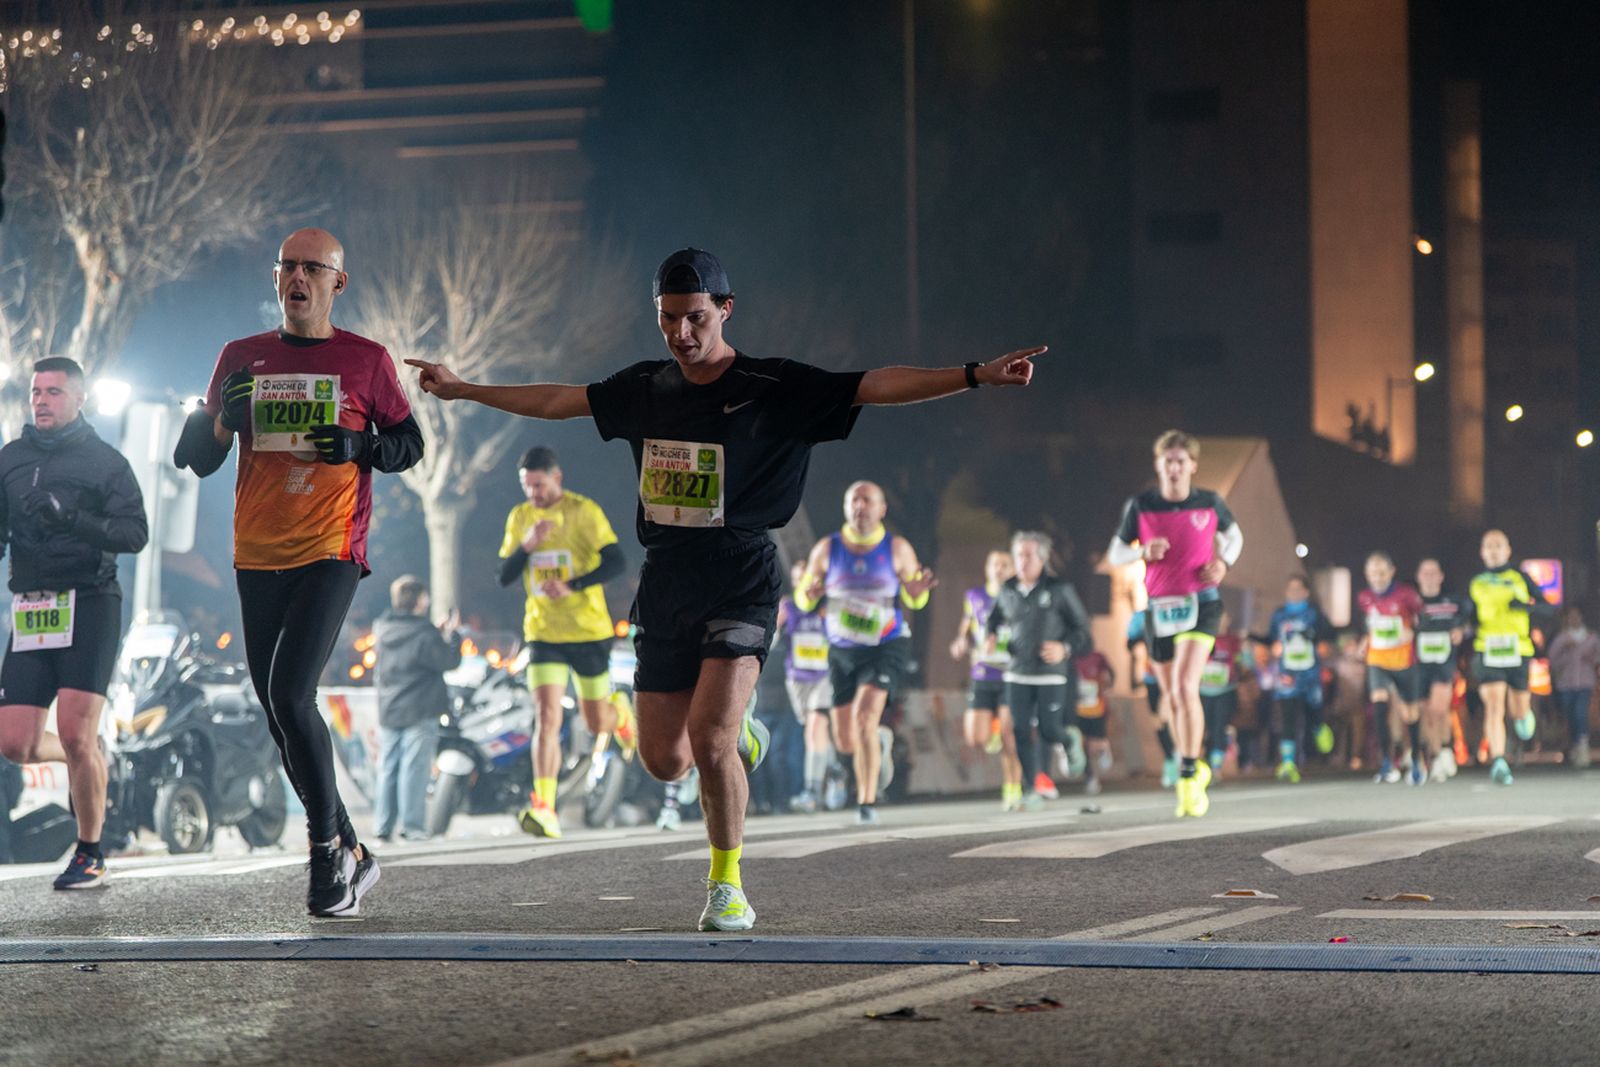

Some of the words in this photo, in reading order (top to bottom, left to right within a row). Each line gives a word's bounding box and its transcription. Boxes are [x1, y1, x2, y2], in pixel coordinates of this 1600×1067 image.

[272, 382, 296, 391] NOCHE
[297, 382, 307, 390] DE
[260, 392, 278, 400] SAN
[264, 401, 326, 424] 12074
[660, 450, 681, 460] NOCHE
[682, 451, 691, 460] DE
[650, 459, 664, 468] SAN
[651, 471, 710, 498] 12827
[25, 609, 60, 629] 8118
